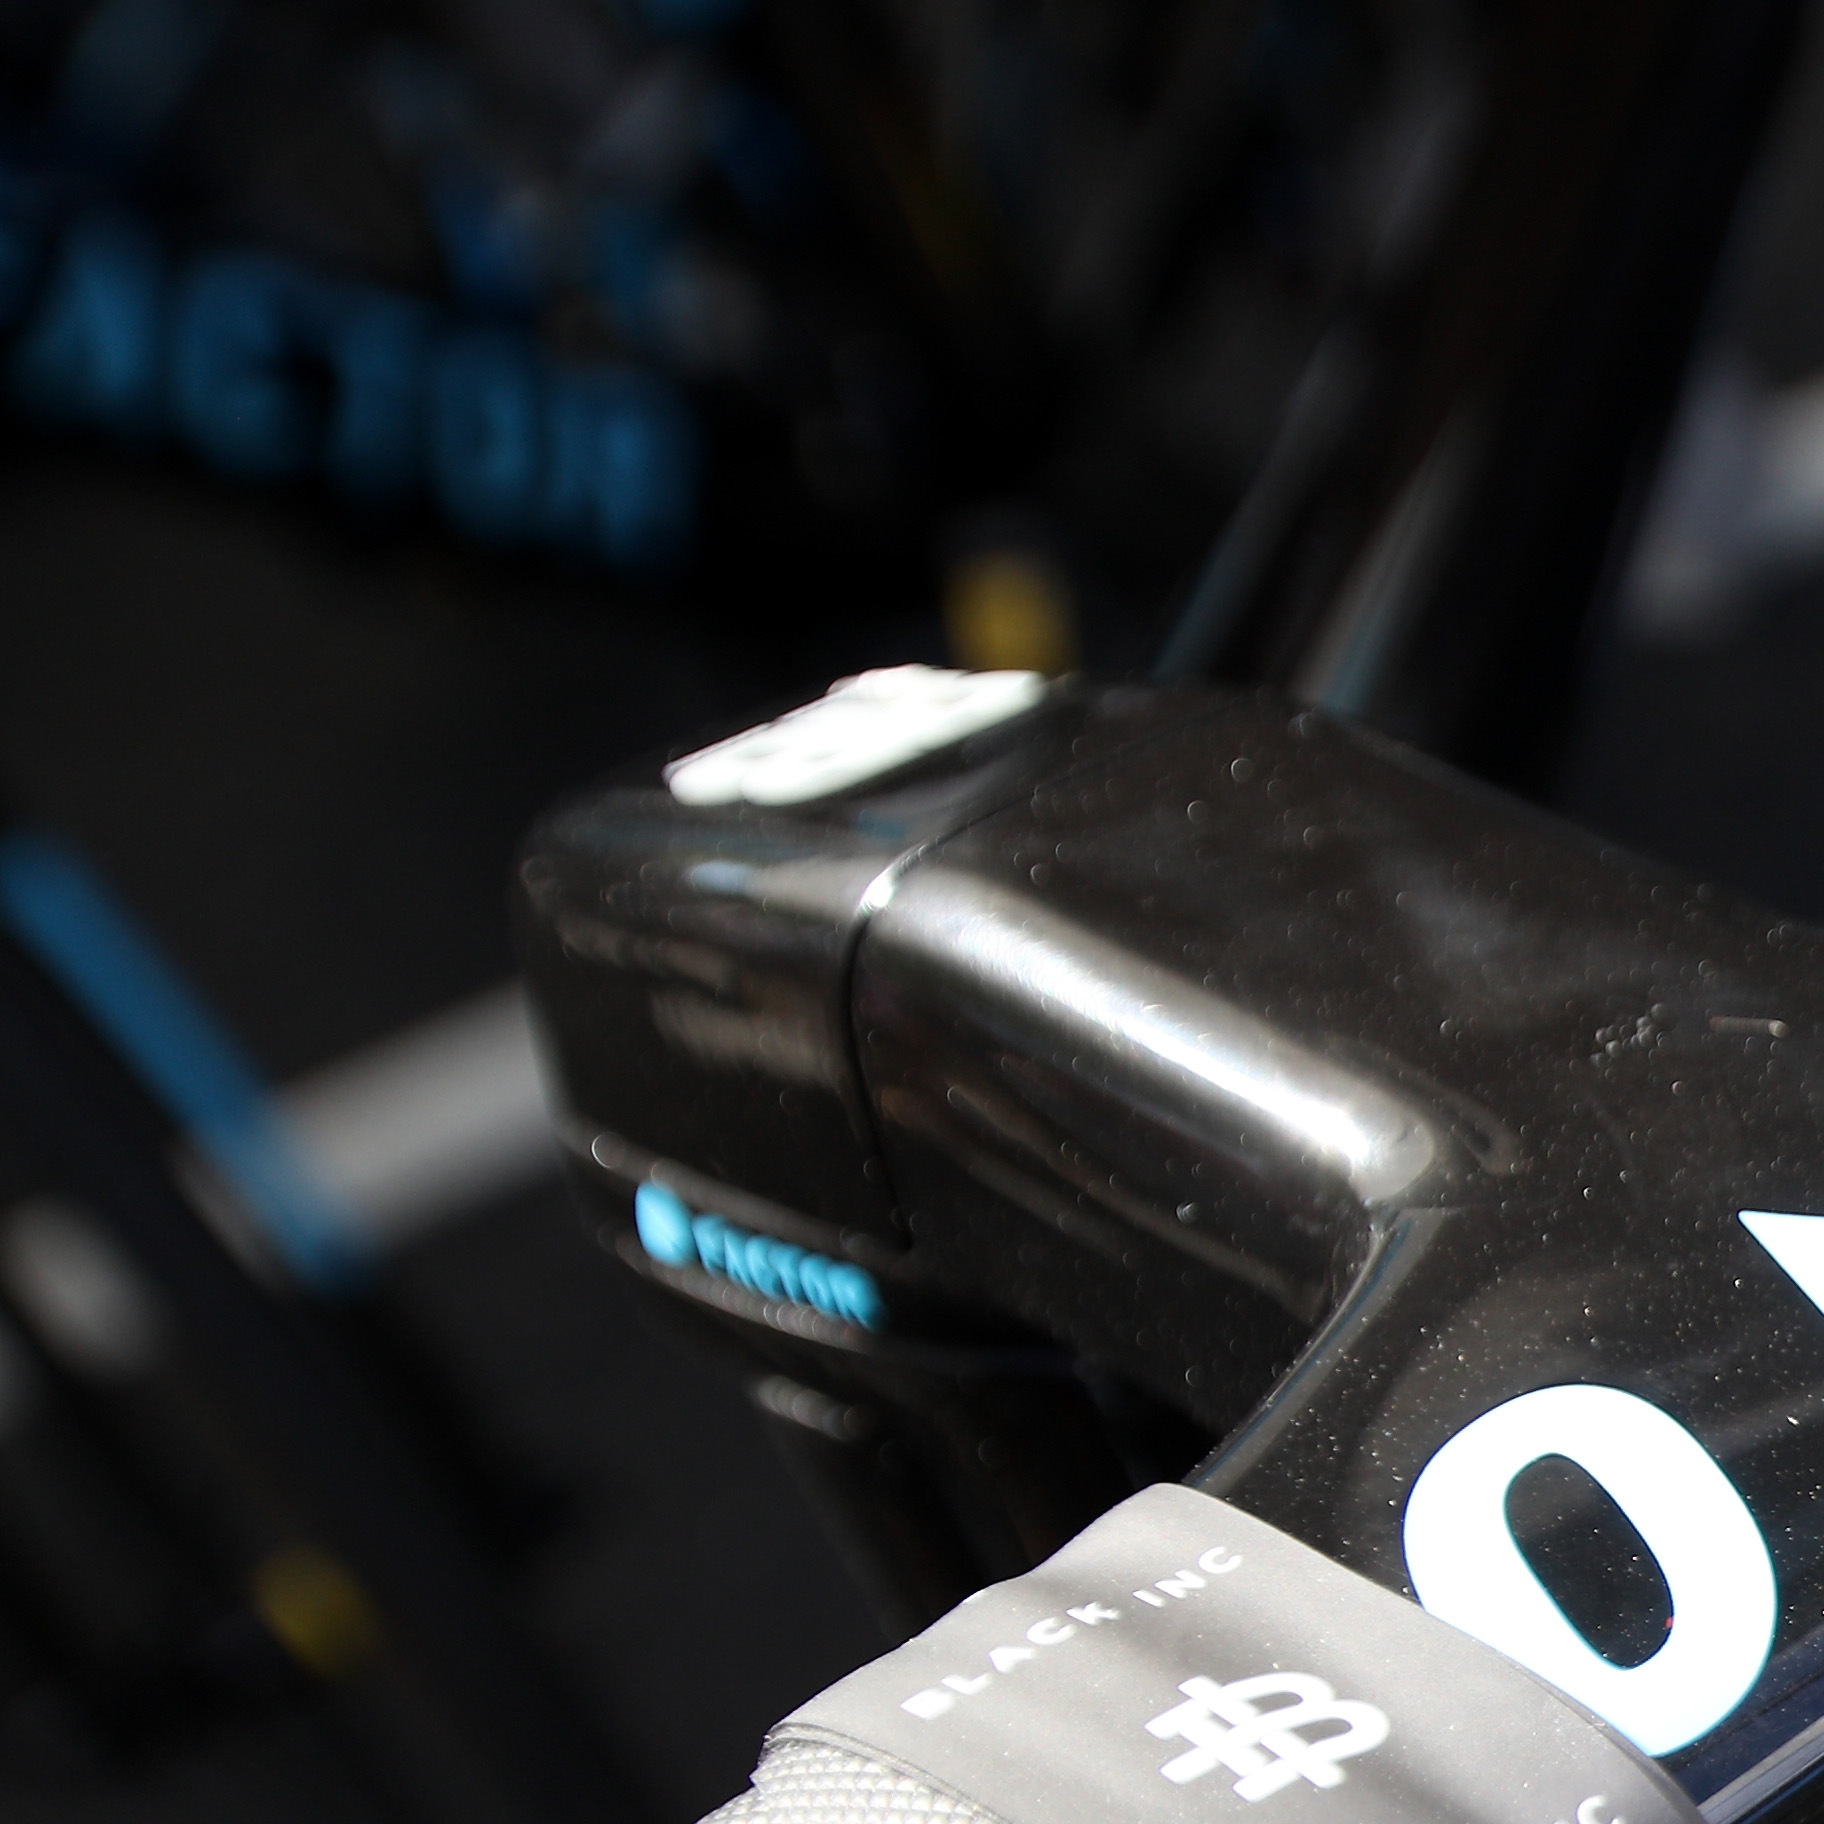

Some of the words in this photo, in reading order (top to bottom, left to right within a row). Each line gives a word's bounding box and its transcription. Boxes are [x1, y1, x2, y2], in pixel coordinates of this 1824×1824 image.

[0, 175, 698, 565] ACTOR
[900, 1602, 1121, 1720] BLACK
[1133, 1546, 1243, 1608] INC
